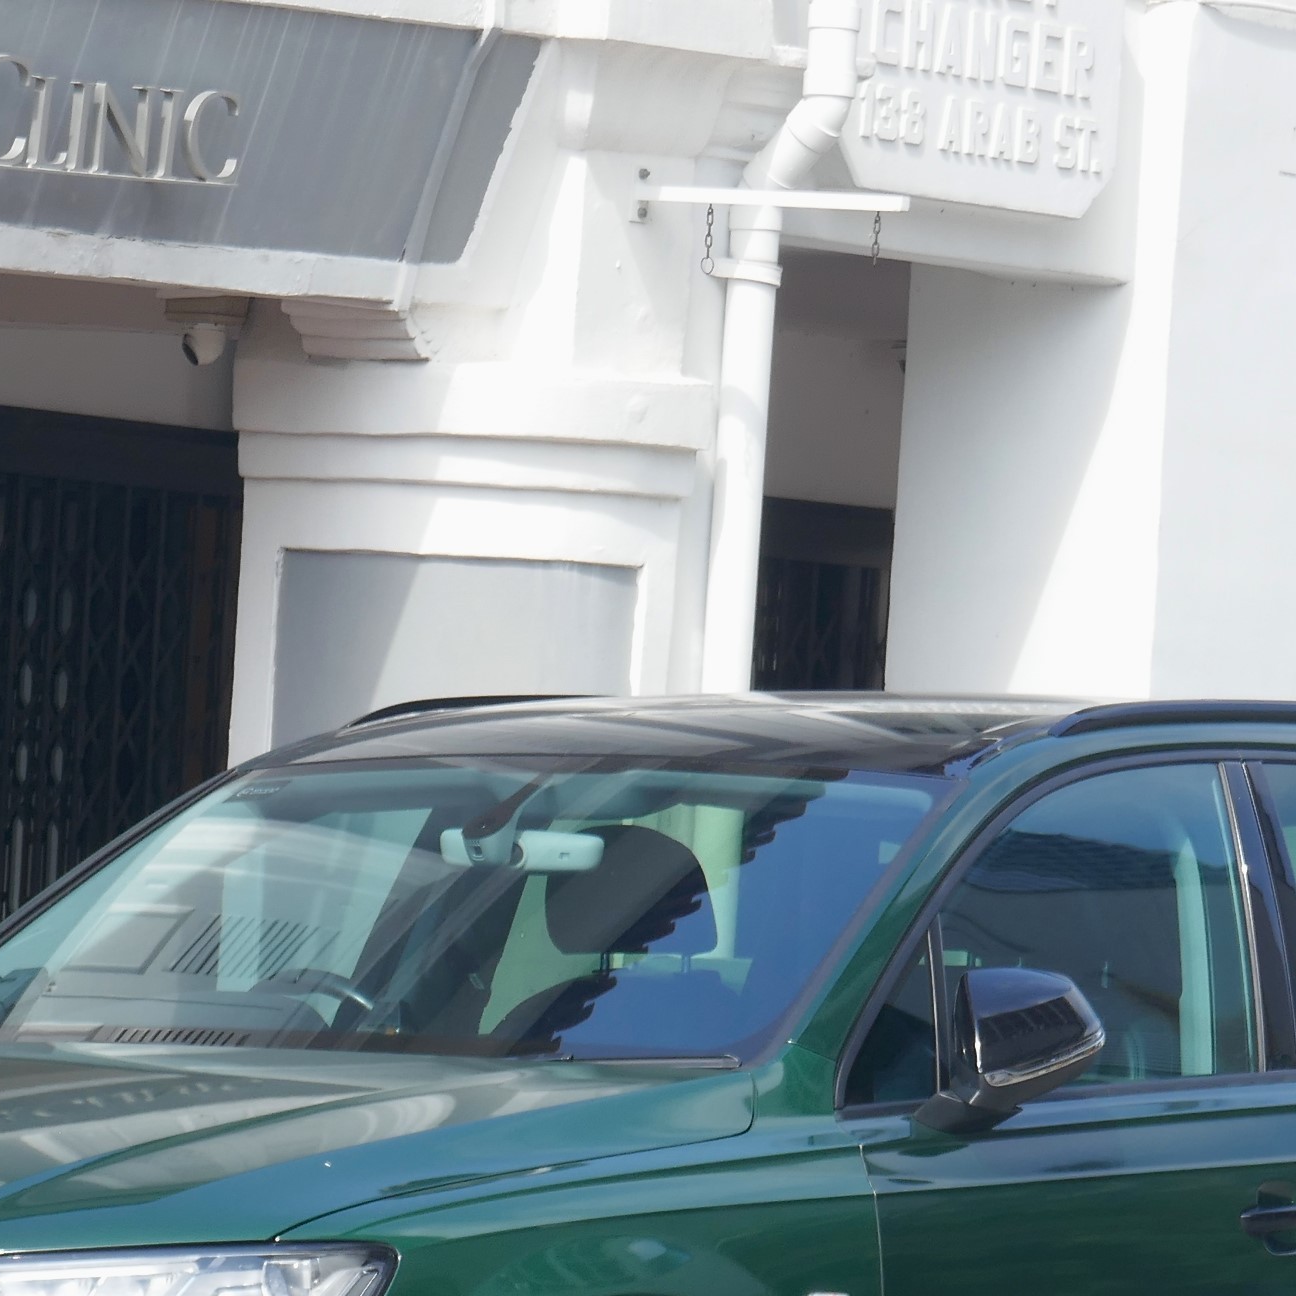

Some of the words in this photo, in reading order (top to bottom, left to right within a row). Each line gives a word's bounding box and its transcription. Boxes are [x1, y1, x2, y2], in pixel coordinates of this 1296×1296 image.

[870, 0, 1096, 100] CHANGER
[937, 95, 1042, 164] ARAB
[1056, 113, 1102, 174] ST.
